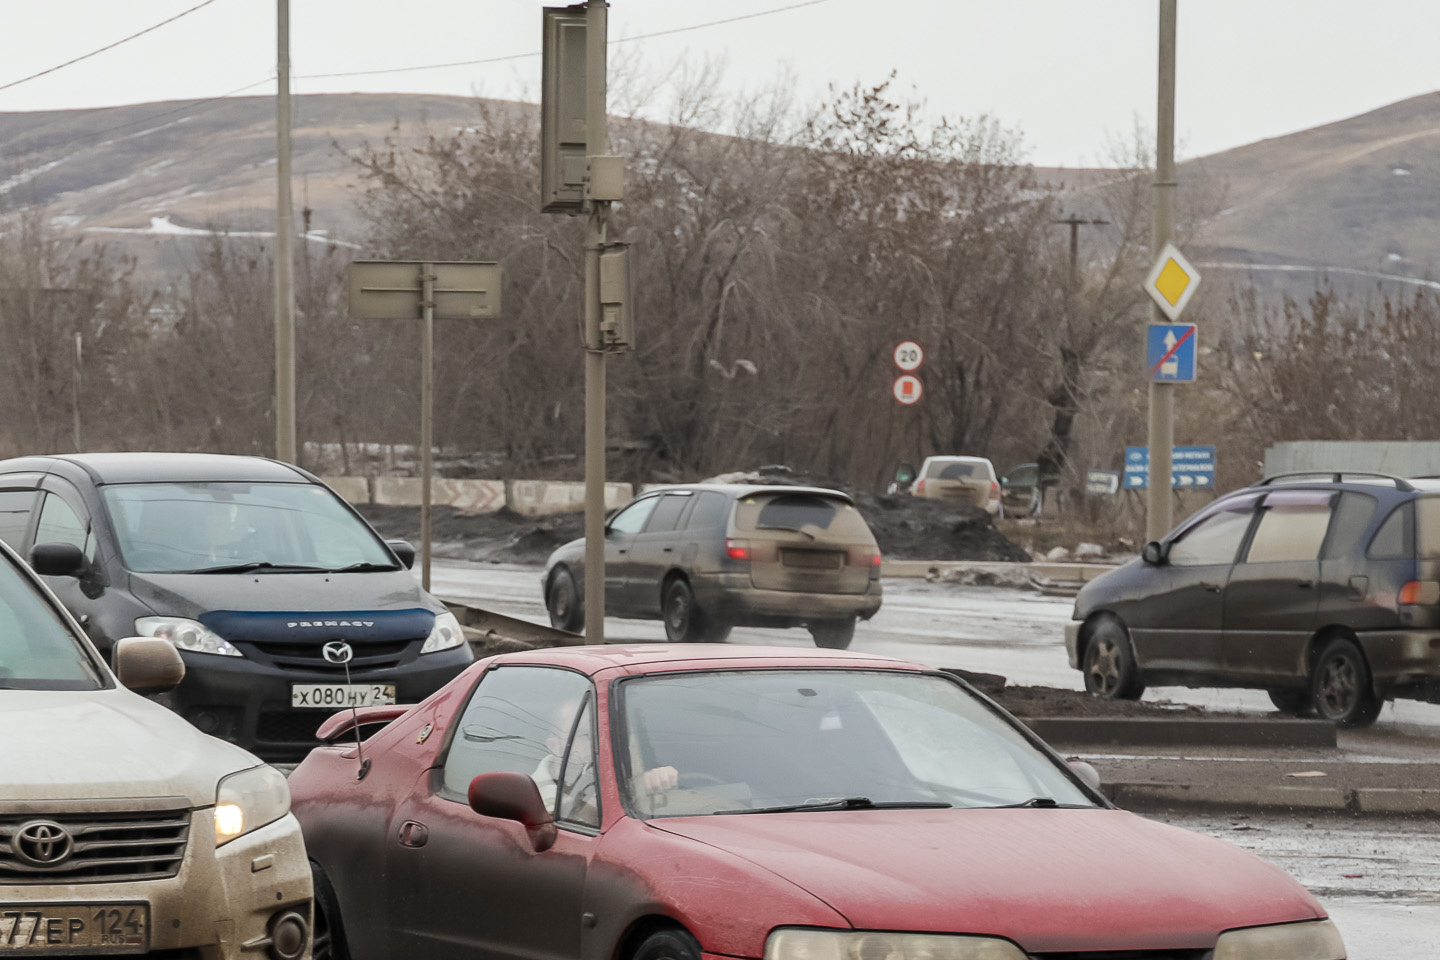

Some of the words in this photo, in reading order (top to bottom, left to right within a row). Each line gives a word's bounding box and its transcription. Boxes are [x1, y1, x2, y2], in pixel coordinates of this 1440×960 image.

[900, 350, 918, 362] 20
[299, 687, 368, 705] Х080НУ
[92, 908, 140, 936] 124
[101, 934, 126, 944] RUS
